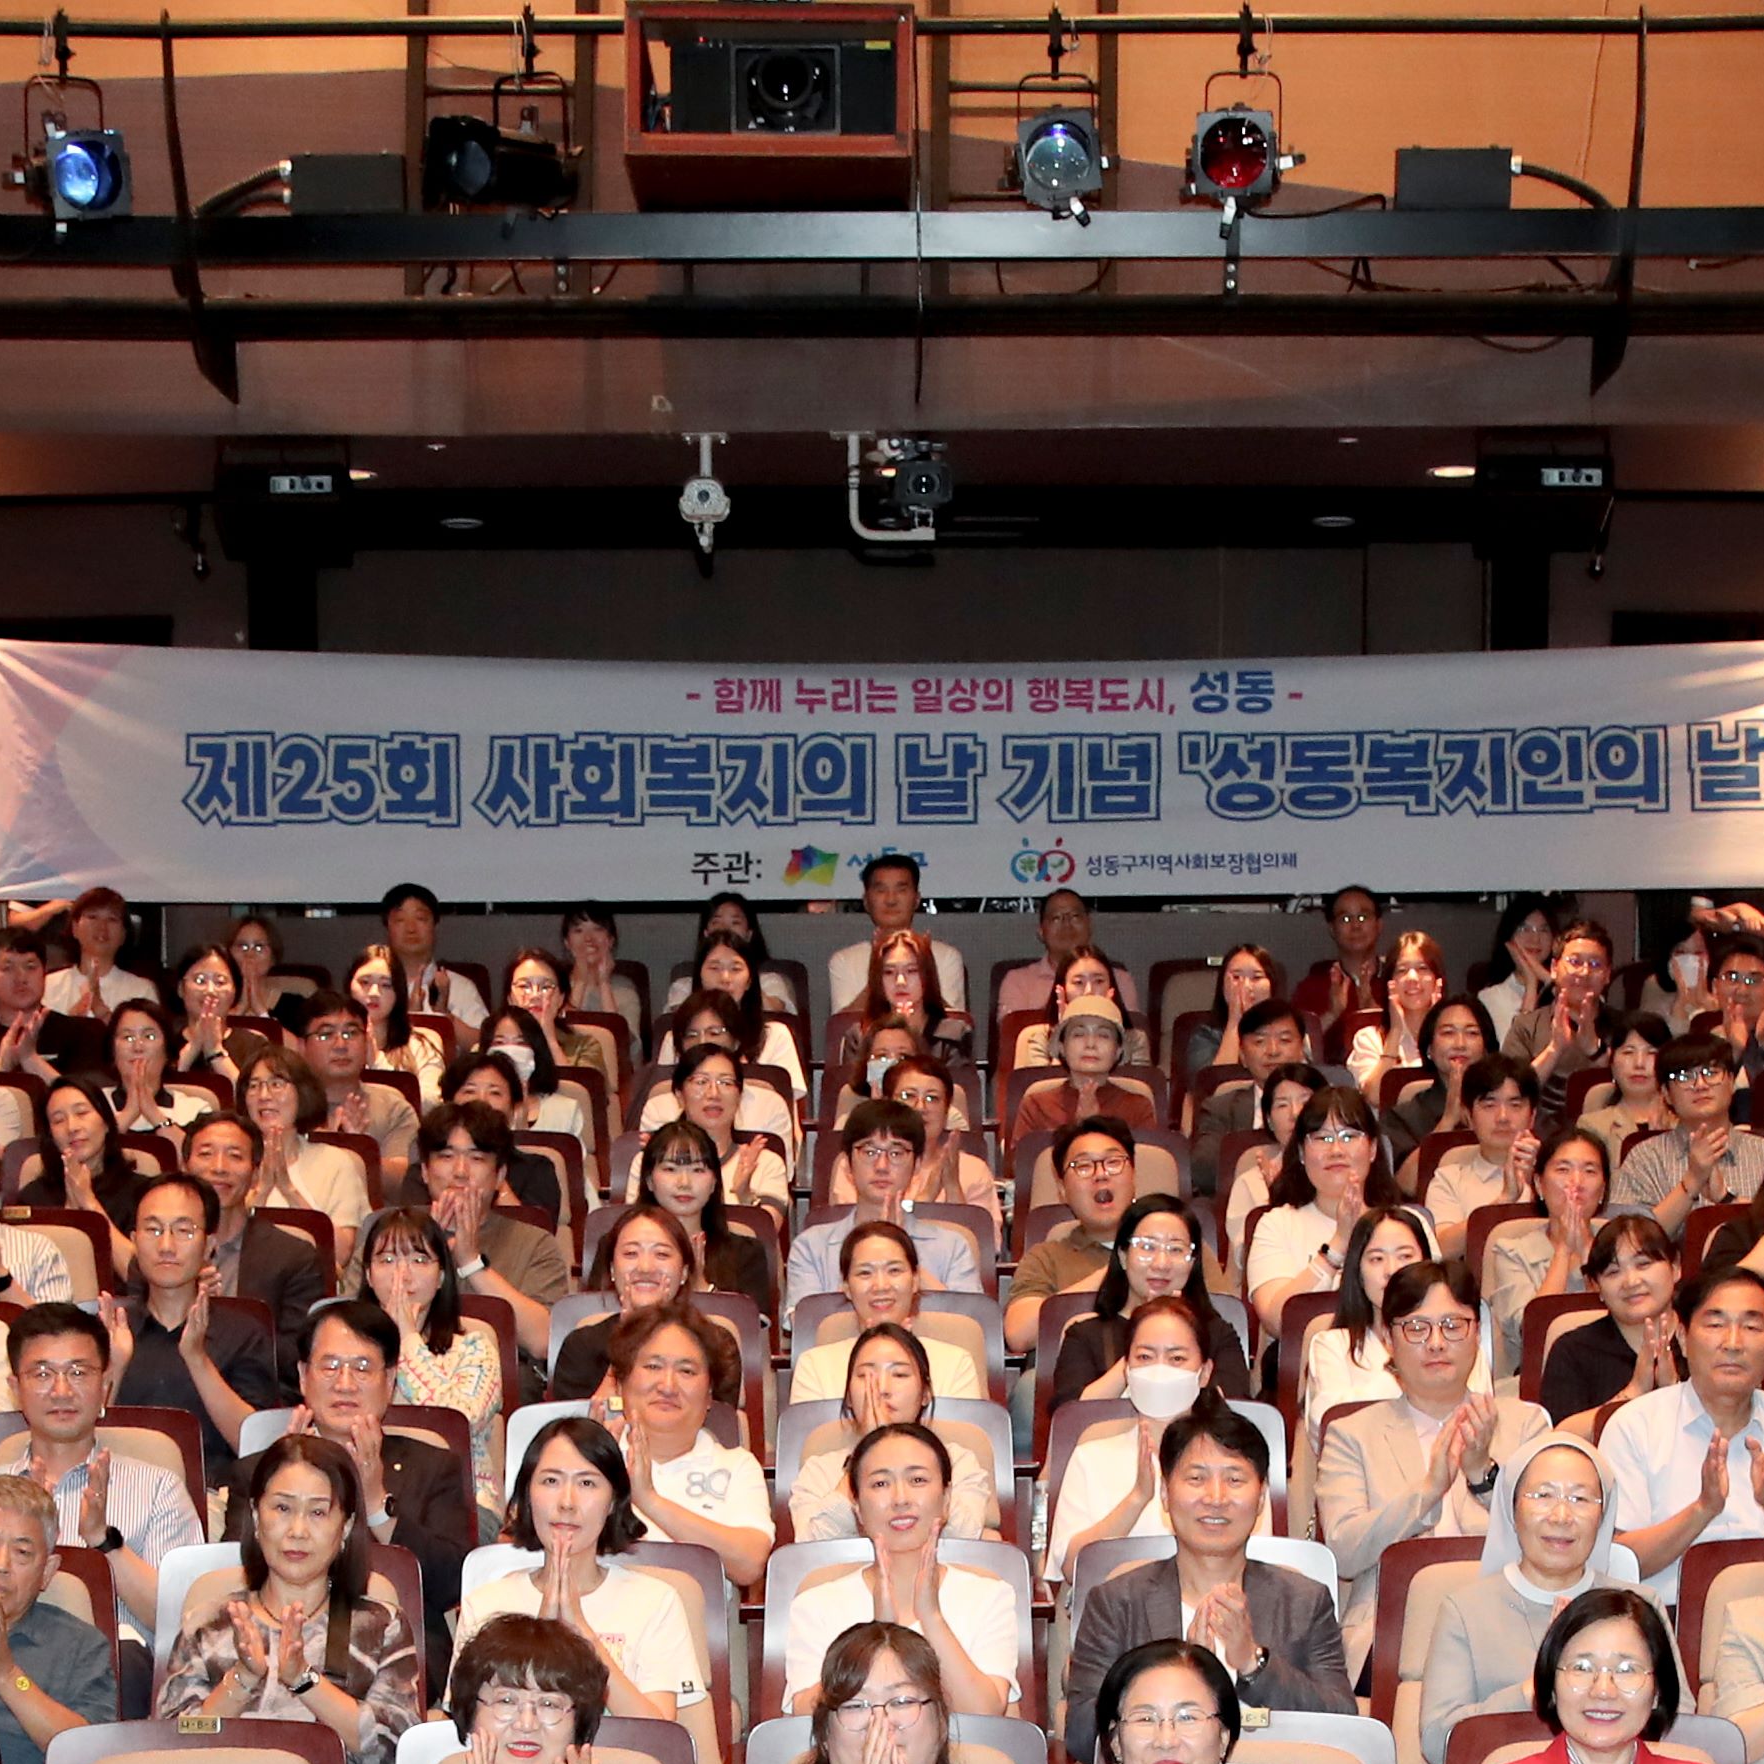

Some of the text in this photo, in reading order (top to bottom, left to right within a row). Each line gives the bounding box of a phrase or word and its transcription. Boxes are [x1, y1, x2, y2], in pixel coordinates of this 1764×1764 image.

[713, 677, 782, 714] 함께
[794, 677, 898, 714] 누리는
[911, 677, 1014, 714] 일상의
[1026, 677, 1176, 715] 행복도시,
[1189, 670, 1276, 714] 성동
[183, 731, 461, 829] 제25회
[474, 732, 876, 829] 사회복지의
[894, 732, 987, 825] 날
[996, 732, 1162, 824] 기념
[691, 851, 763, 885] 주관:
[1086, 852, 1298, 876] 성동구지역사회보장협의체
